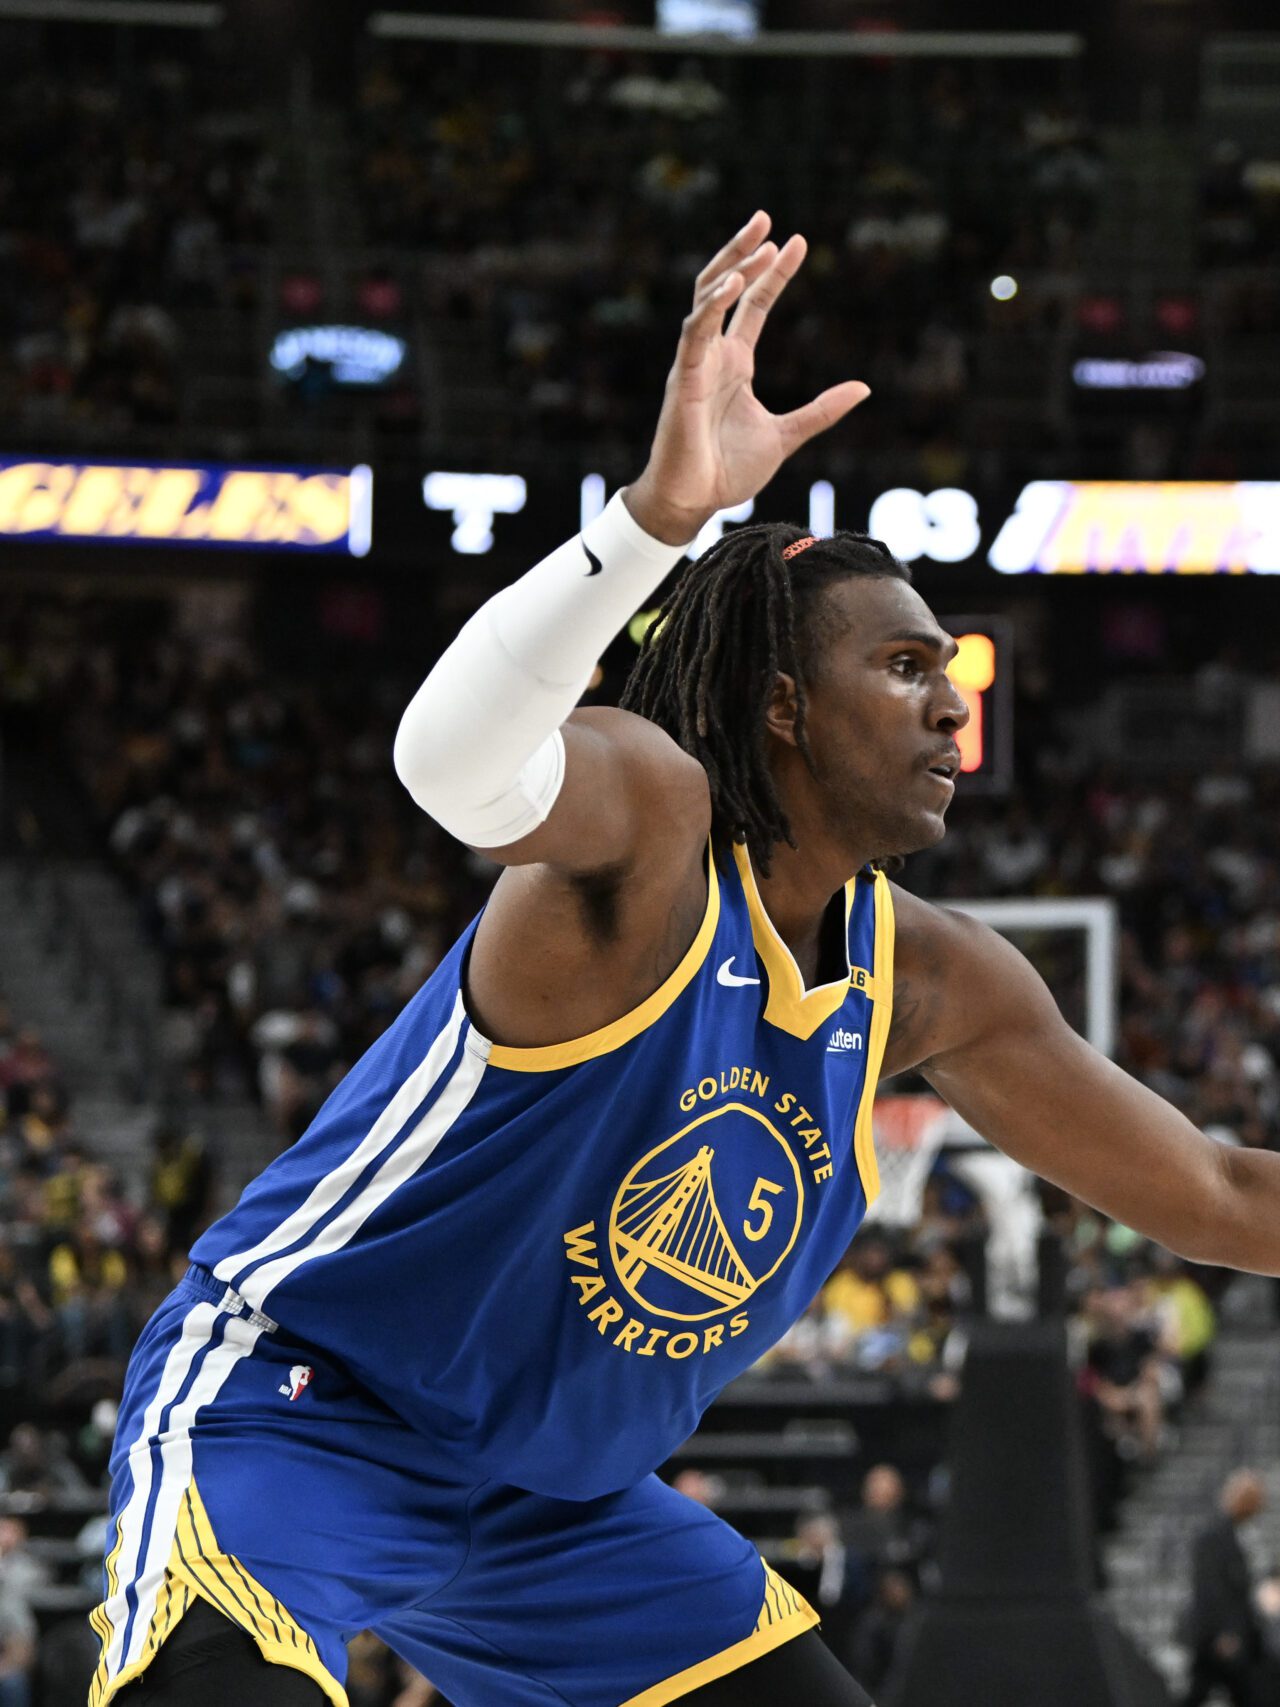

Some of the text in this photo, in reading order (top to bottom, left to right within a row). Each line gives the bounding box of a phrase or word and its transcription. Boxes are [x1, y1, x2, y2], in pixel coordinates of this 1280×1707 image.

[678, 1066, 770, 1112] GOLDEN
[774, 1092, 835, 1185] STATE
[742, 1177, 786, 1242] 5
[563, 1220, 750, 1361] WARRIORS
[277, 1383, 292, 1397] NBA
